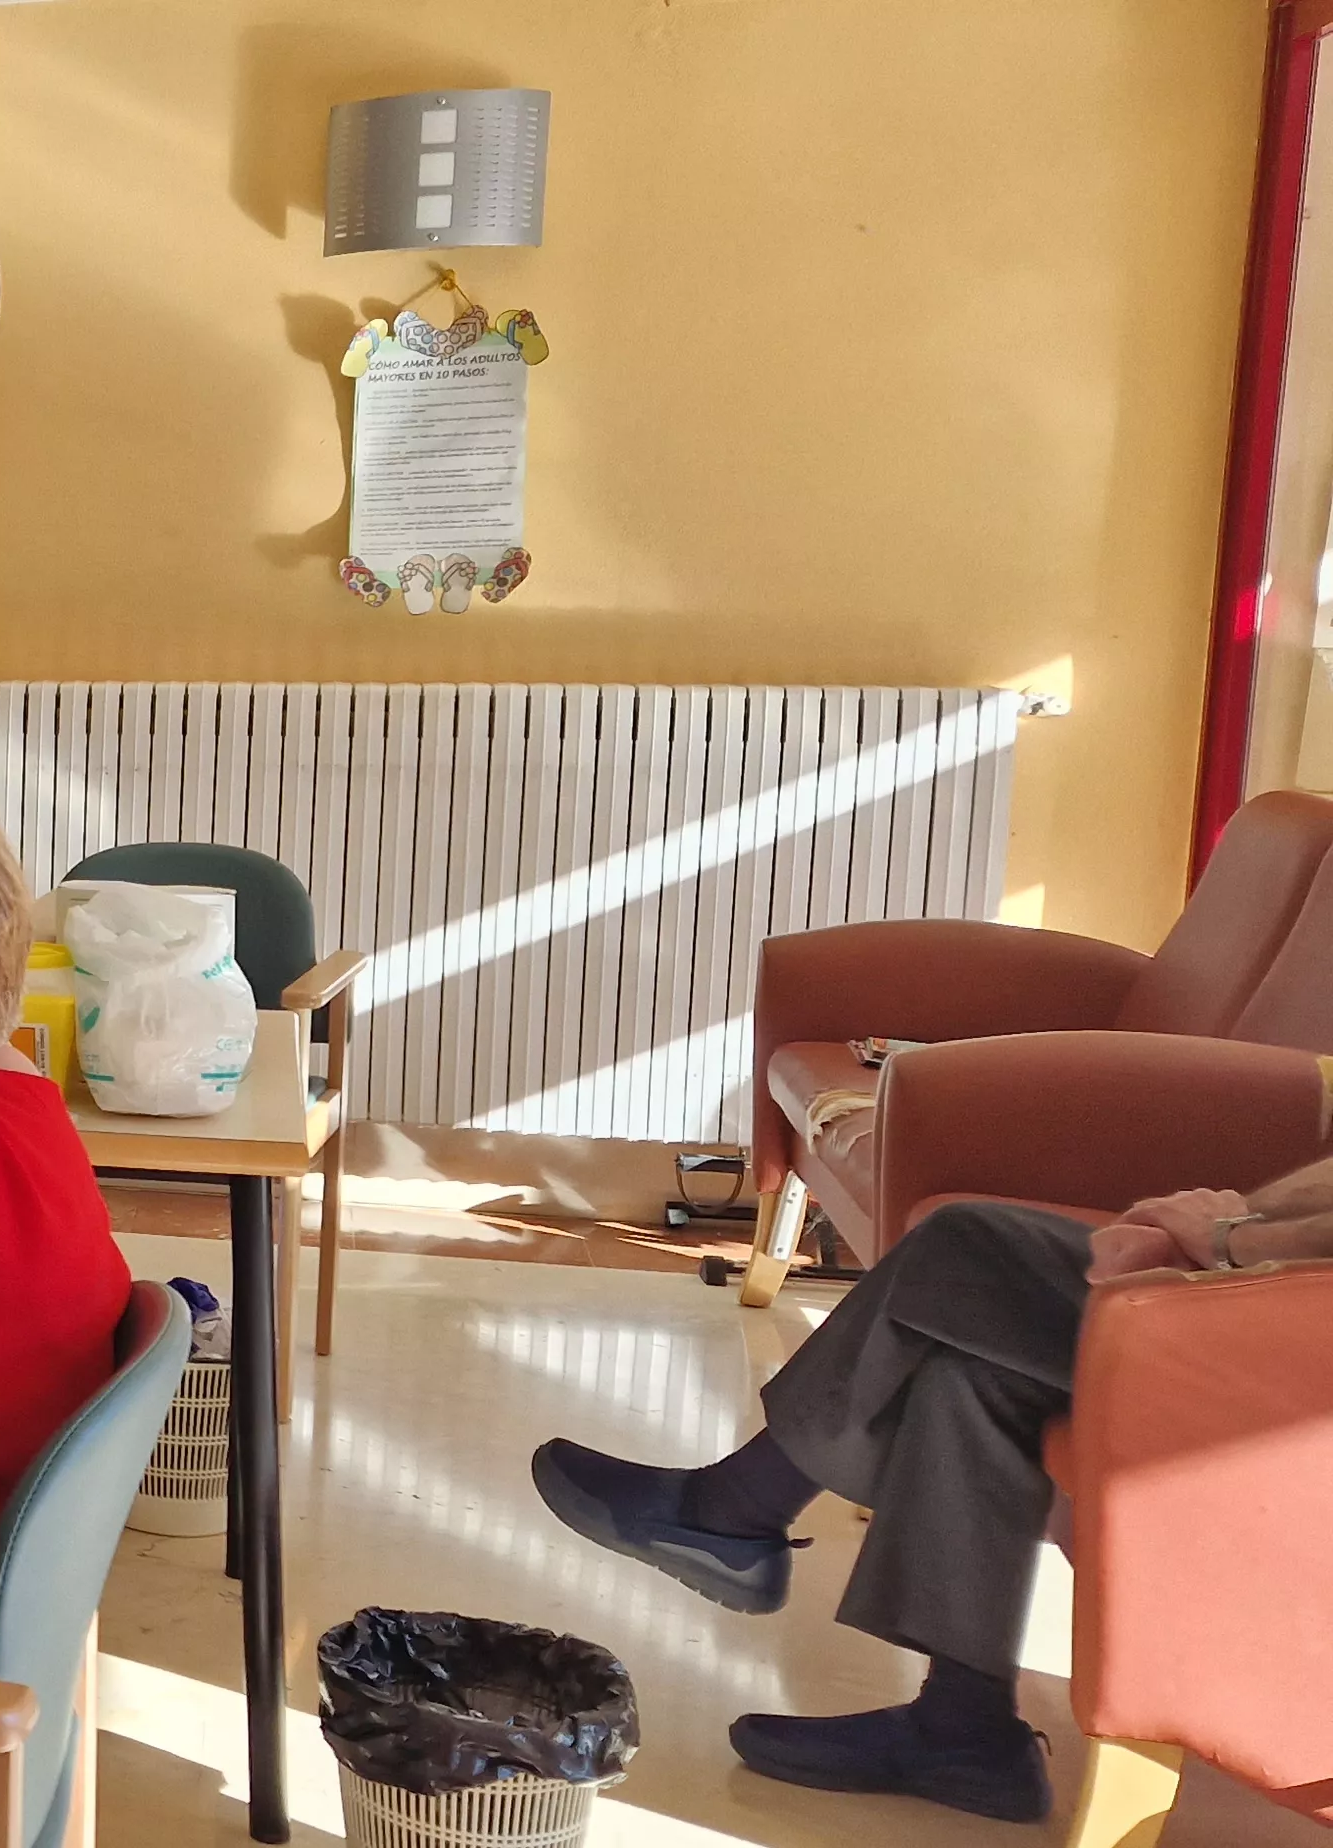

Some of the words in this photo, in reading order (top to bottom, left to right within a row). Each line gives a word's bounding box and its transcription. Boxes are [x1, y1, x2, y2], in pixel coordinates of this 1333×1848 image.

[402, 359, 434, 368] AMAR
[436, 356, 444, 367] A
[448, 356, 467, 366] LOS
[470, 352, 521, 364] ADULTOS
[368, 372, 416, 383] MAYORES
[419, 370, 434, 380] EN
[436, 370, 450, 380] 10
